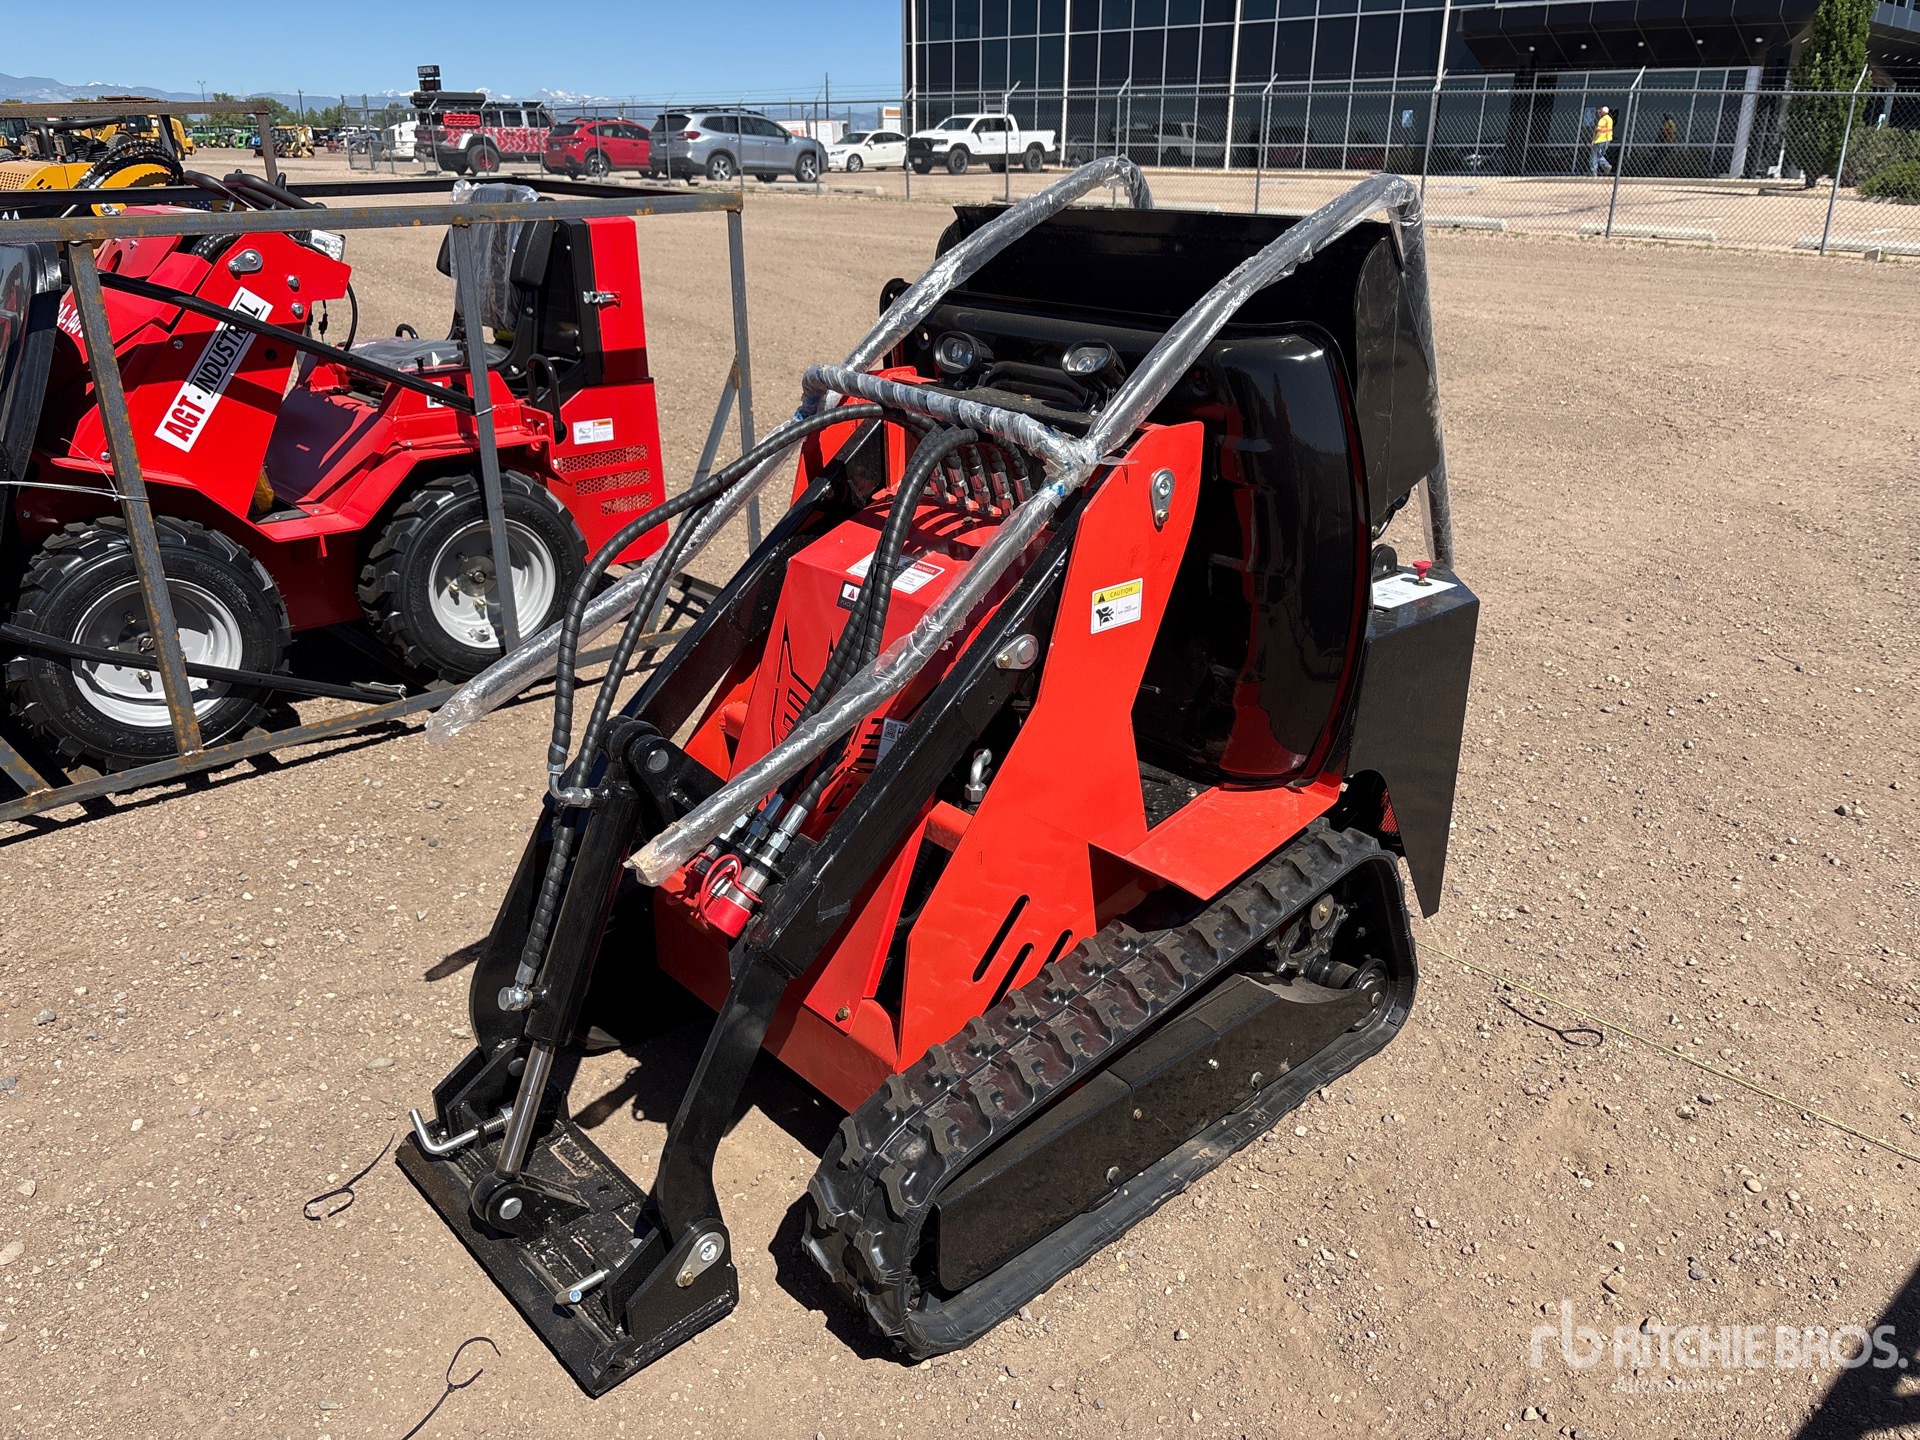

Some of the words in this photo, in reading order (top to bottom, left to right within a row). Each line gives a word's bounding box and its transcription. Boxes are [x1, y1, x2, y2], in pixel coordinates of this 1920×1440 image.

[164, 395, 205, 442] AGT
[193, 303, 260, 395] INDUSTRL
[914, 564, 936, 573] DANGER
[1110, 587, 1133, 598] CAUTION
